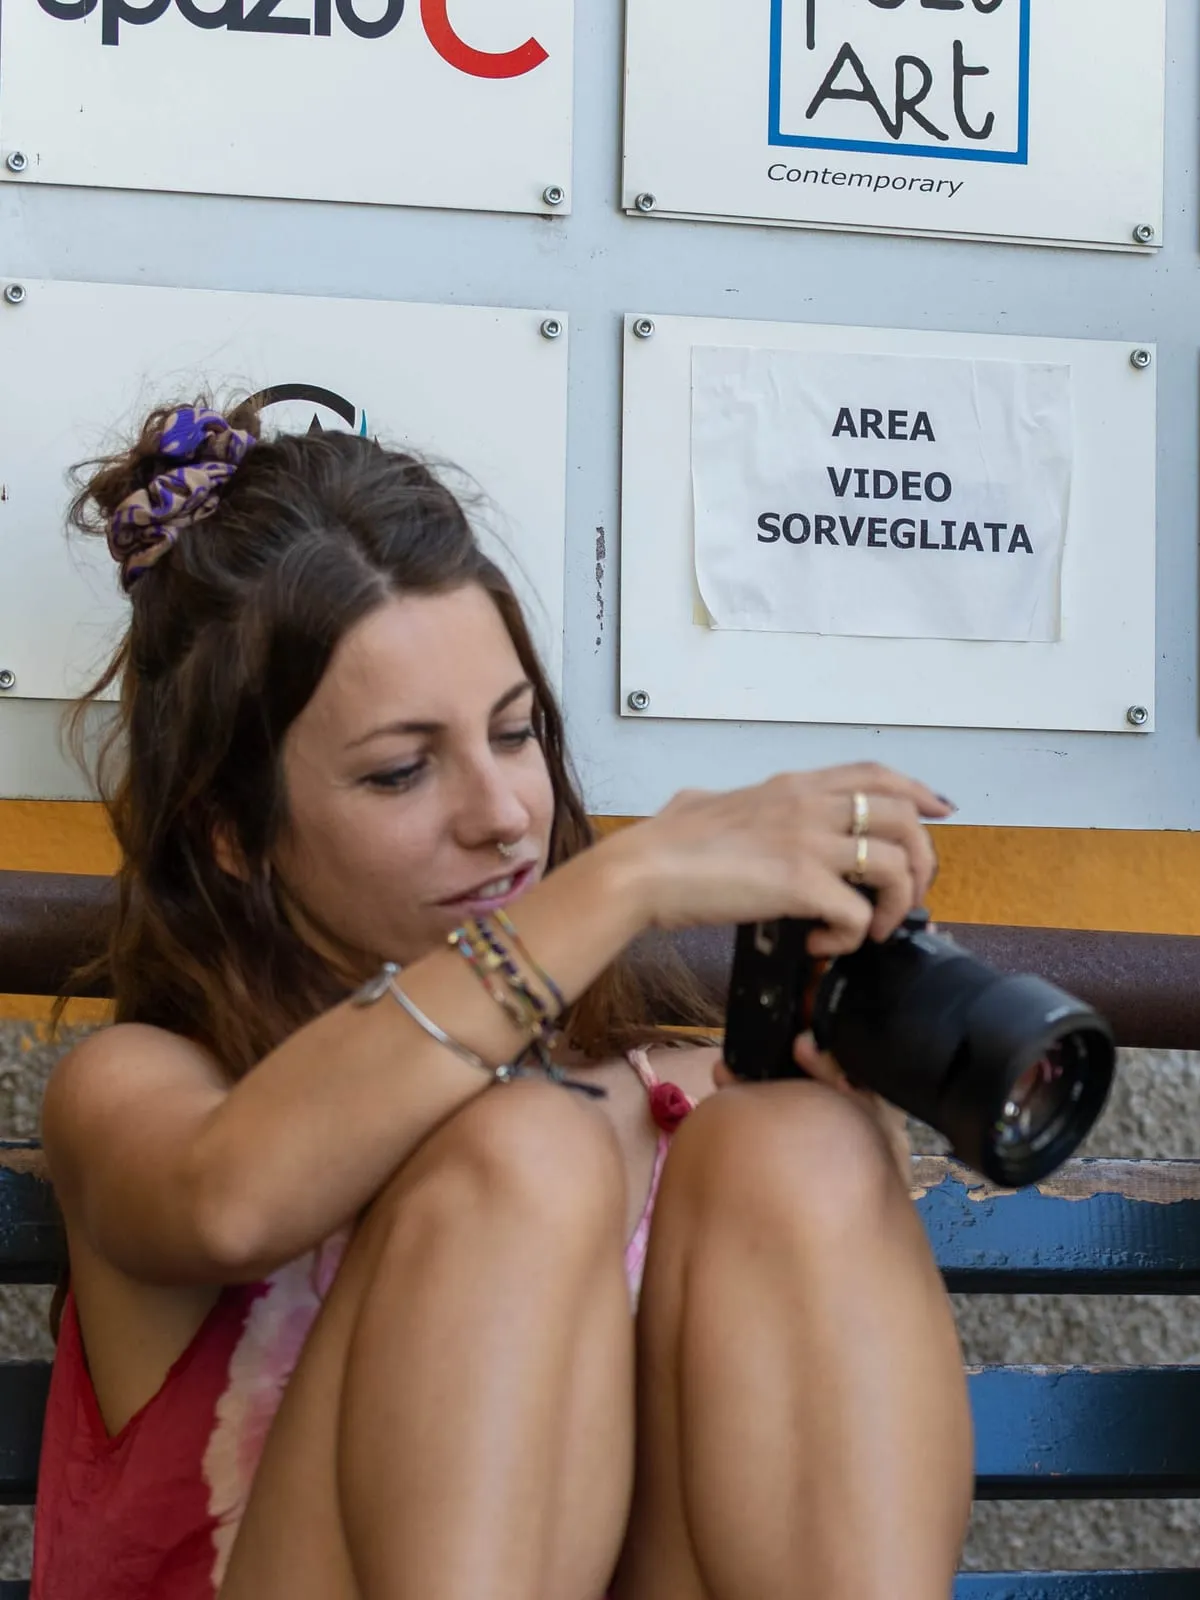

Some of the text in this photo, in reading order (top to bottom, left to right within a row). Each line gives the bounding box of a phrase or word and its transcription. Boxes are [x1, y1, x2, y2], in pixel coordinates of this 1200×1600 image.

[767, 163, 964, 198] Contemporary
[832, 407, 936, 442] AREA
[826, 466, 952, 502] VIDEO
[757, 512, 1034, 554] SORVEGLIATA
